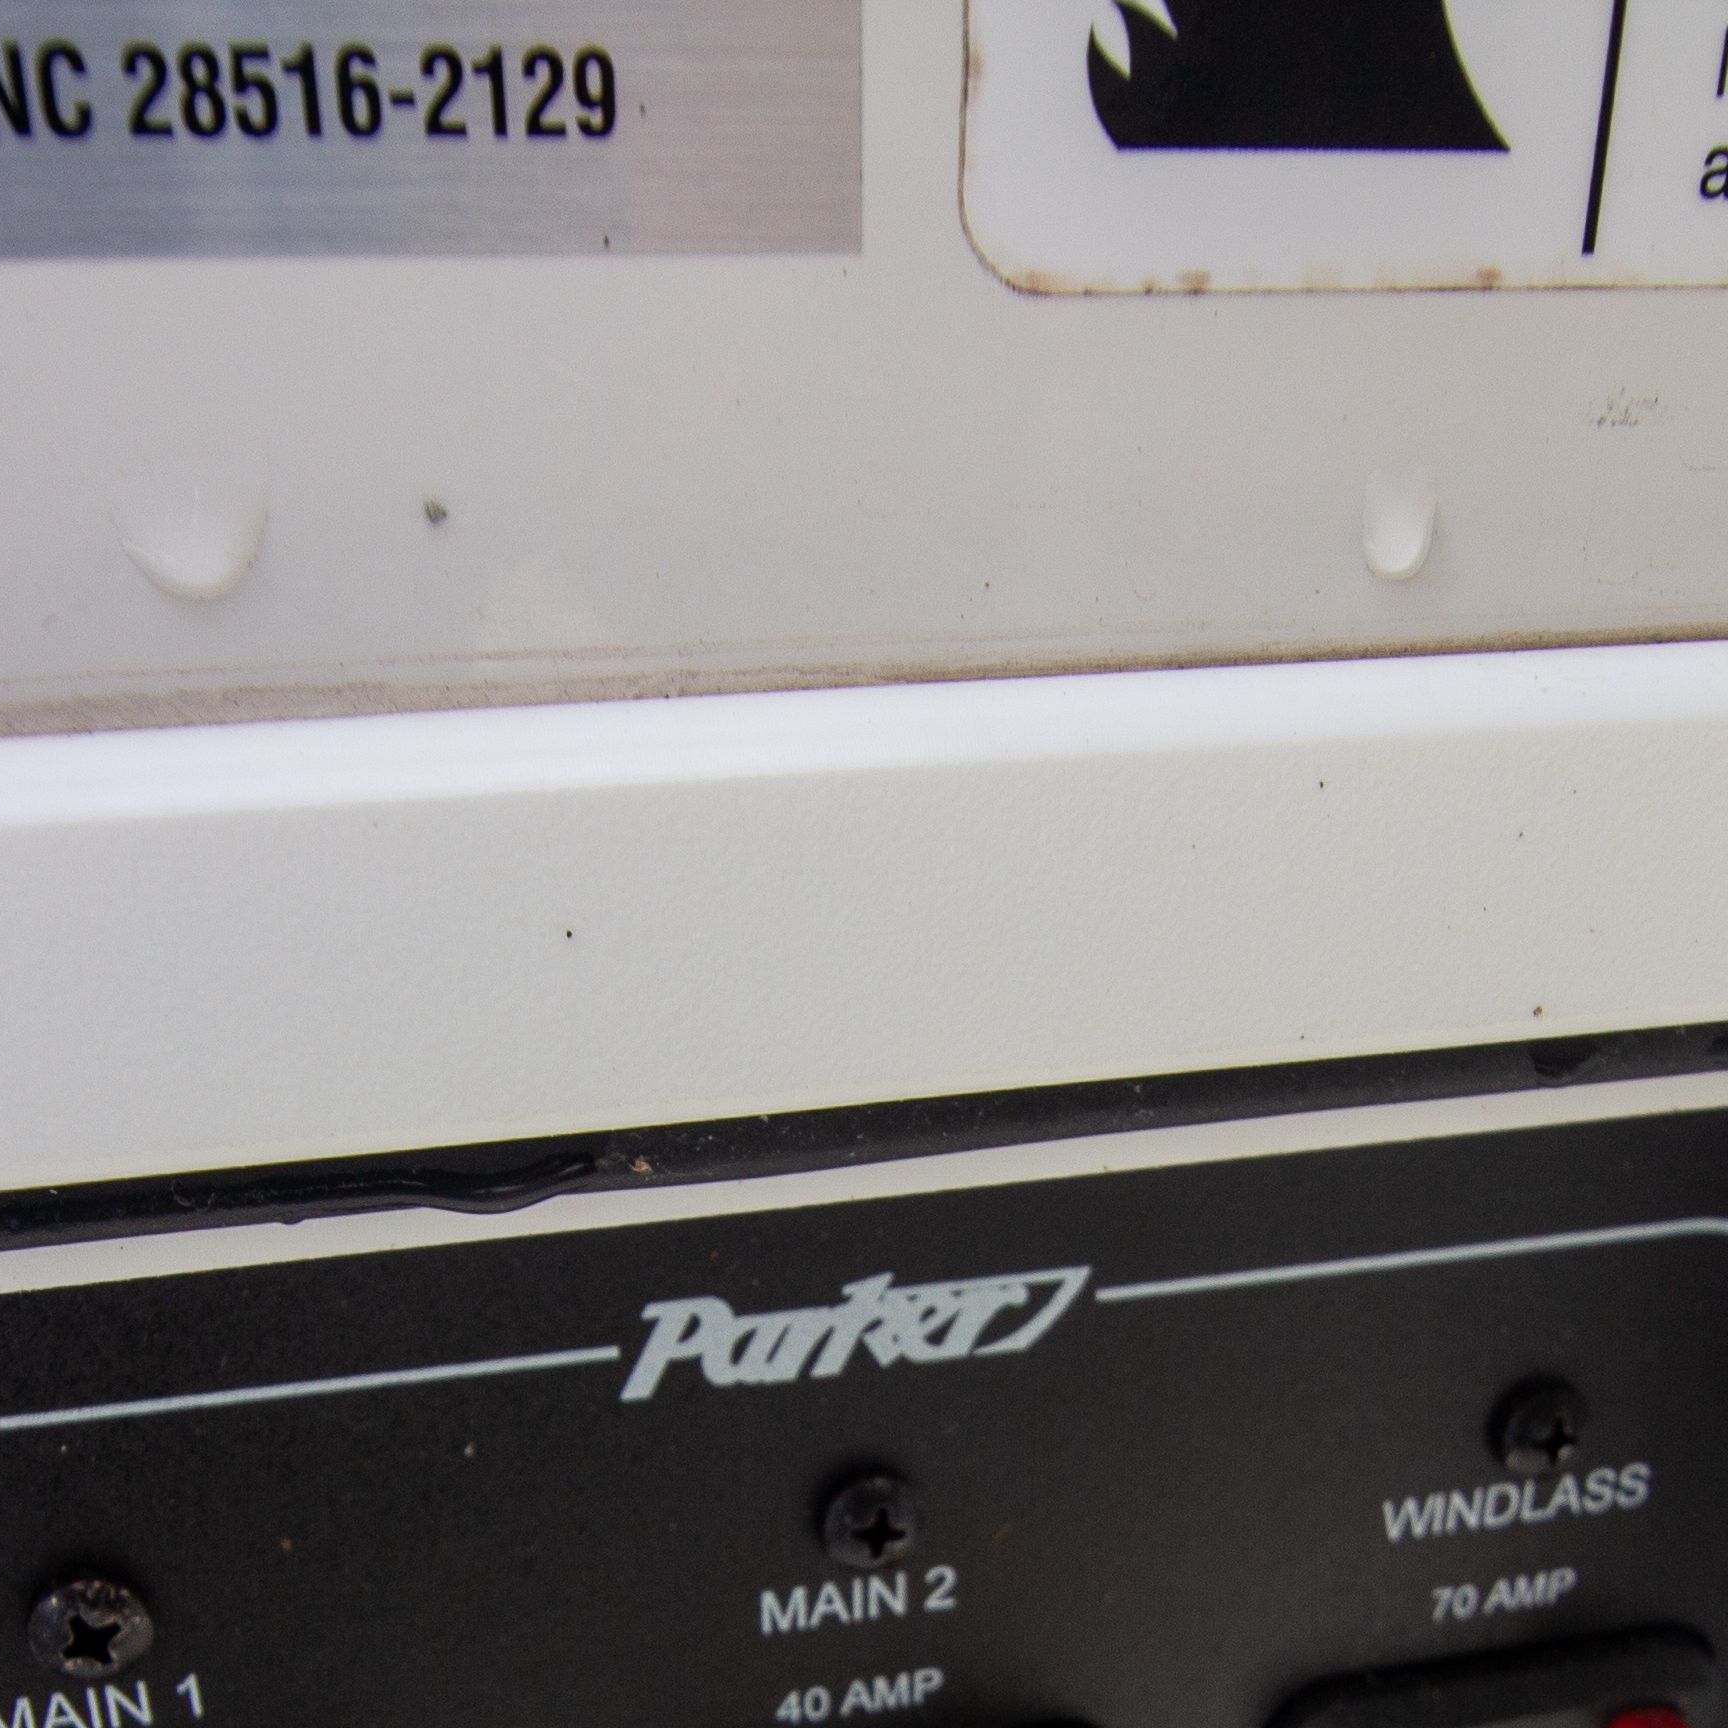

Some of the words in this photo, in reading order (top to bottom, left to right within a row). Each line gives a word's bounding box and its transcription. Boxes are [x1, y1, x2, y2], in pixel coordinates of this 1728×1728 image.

[120, 42, 617, 142] 28516-2129
[620, 1265, 1092, 1402] Parker
[1381, 1462, 1651, 1544] WINDLASS
[760, 1571, 908, 1635] MAIN
[923, 1564, 957, 1611] 2
[1431, 1583, 1479, 1622] 70
[1482, 1566, 1577, 1614] AMP
[176, 1673, 204, 1718] 1
[775, 1685, 832, 1724] 40
[839, 1666, 944, 1717] AMP
